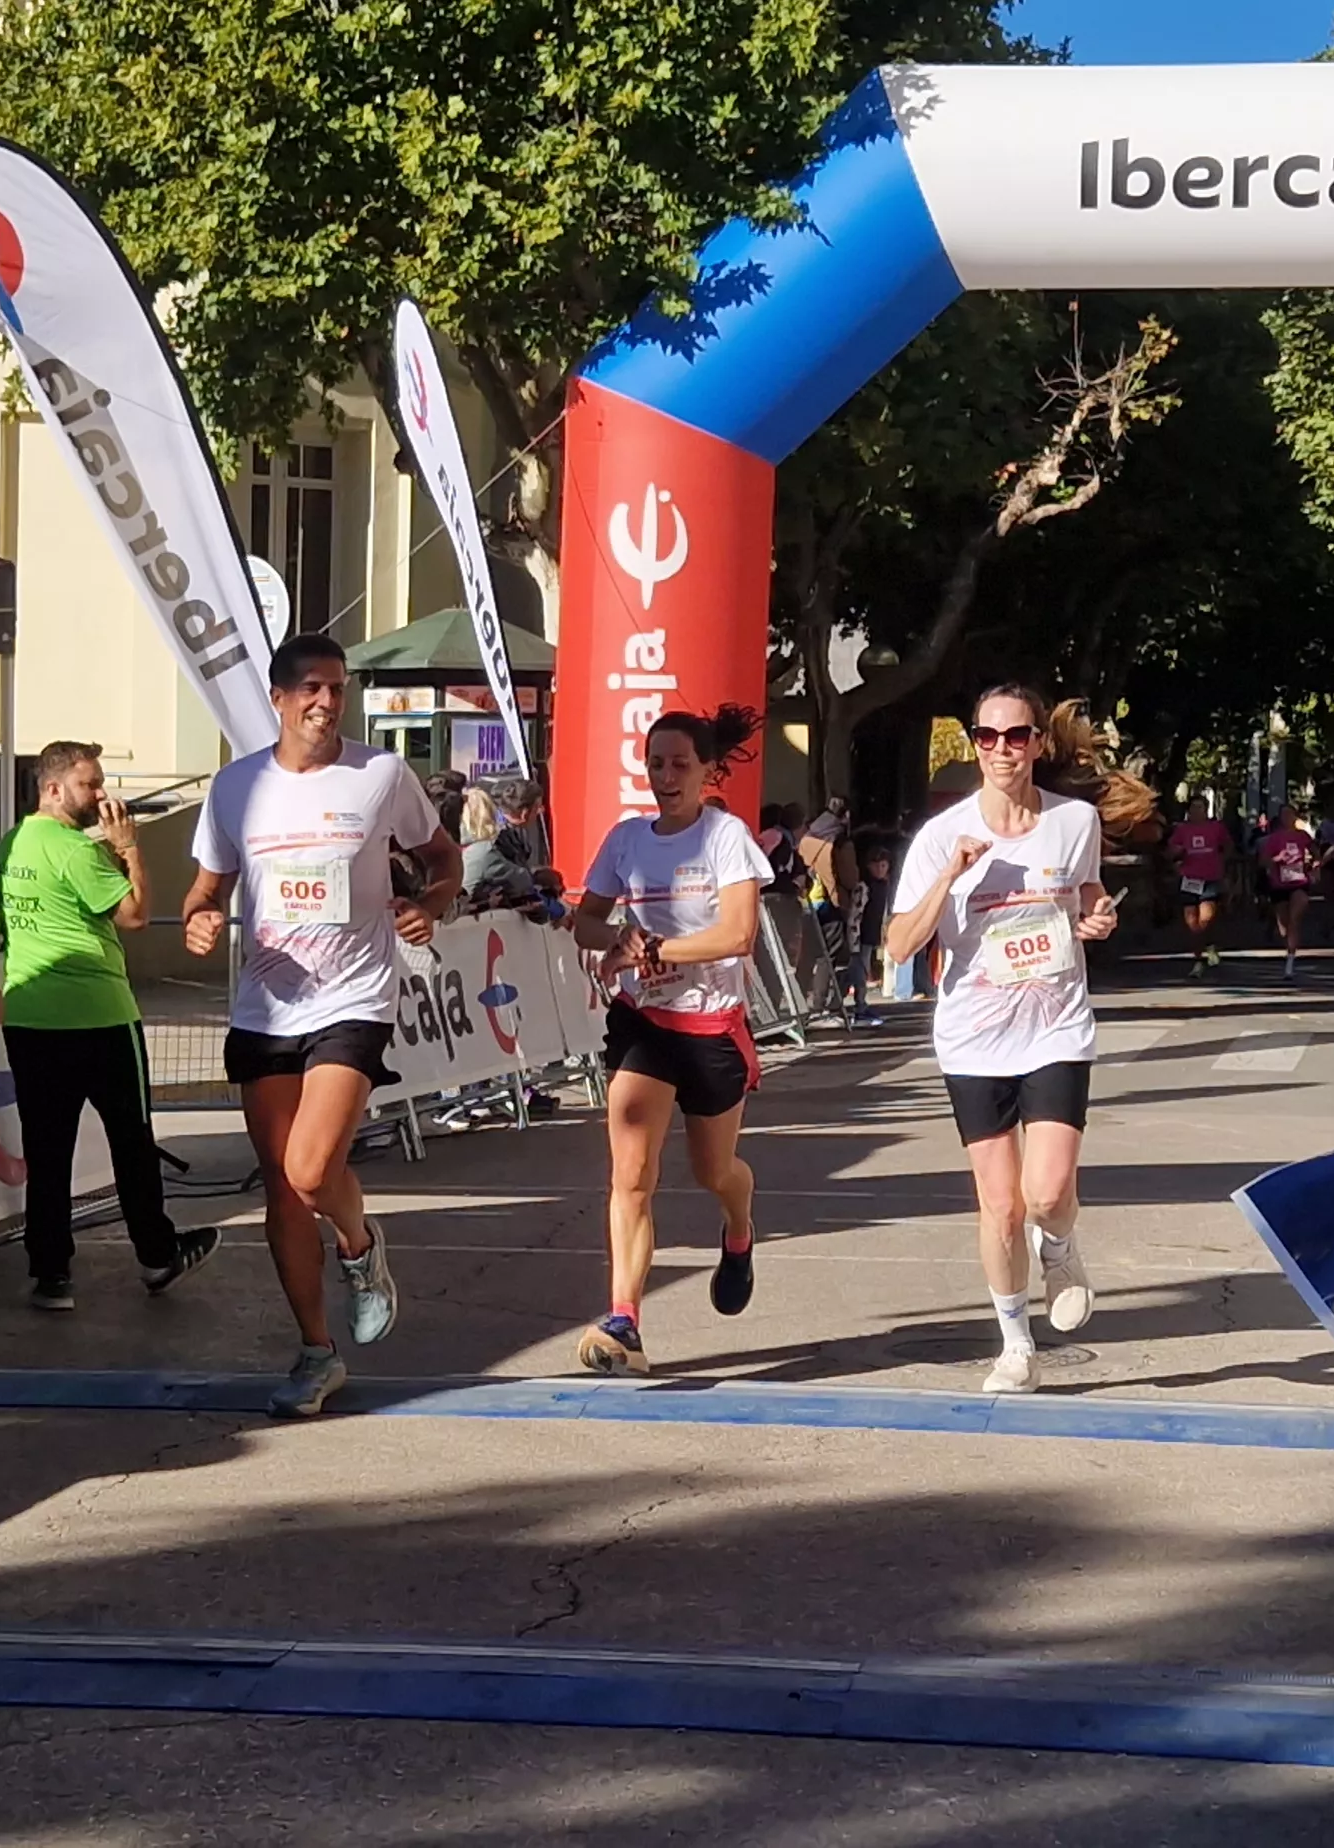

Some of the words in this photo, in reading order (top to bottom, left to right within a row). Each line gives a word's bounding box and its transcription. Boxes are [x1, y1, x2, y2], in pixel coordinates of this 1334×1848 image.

[607, 628, 677, 820] rcaja
[478, 725, 505, 760] BIEN
[280, 881, 327, 900] 606
[1004, 934, 1051, 960] 608
[389, 944, 474, 1062] caja
